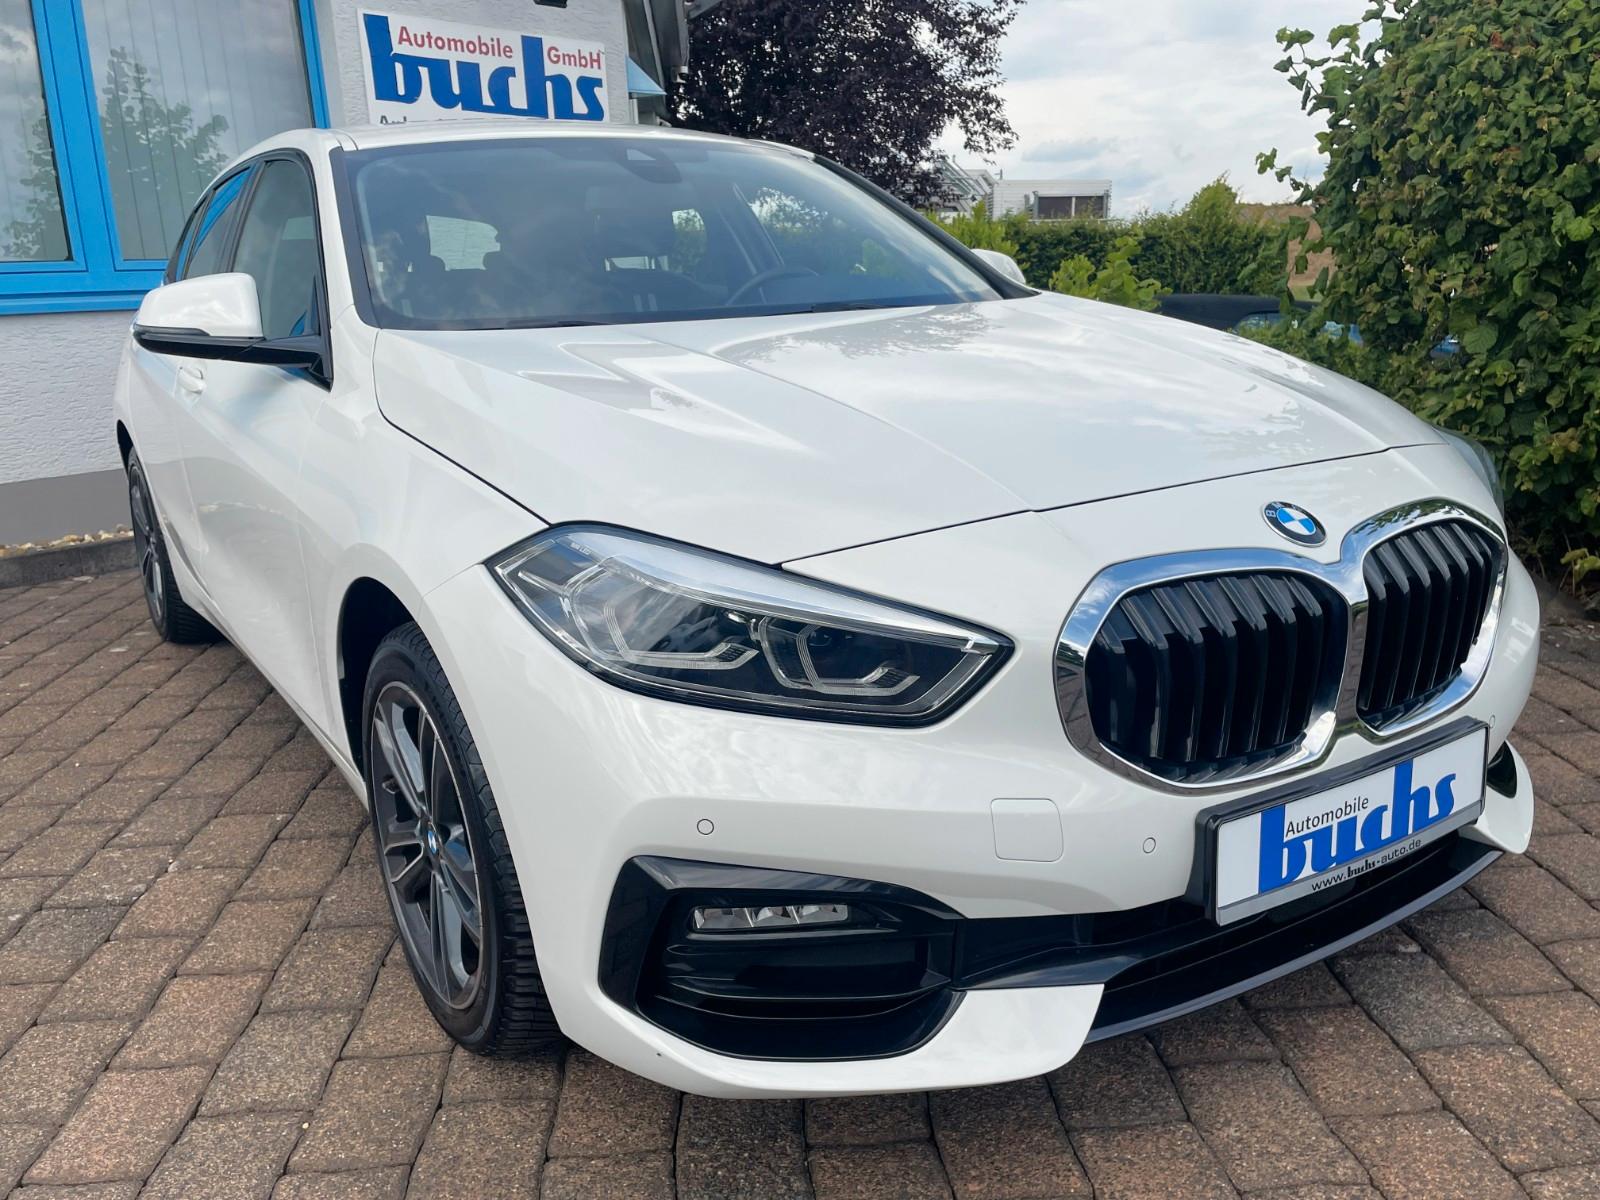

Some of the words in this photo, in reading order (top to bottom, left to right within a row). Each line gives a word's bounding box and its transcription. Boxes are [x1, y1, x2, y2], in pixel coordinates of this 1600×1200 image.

[363, 13, 605, 122] buchs
[397, 26, 514, 59] Automobile
[547, 46, 602, 70] GmbH
[1259, 758, 1457, 896] buchs
[1285, 796, 1370, 838] Automobile
[1311, 838, 1422, 891] www.buchs-auto.de
